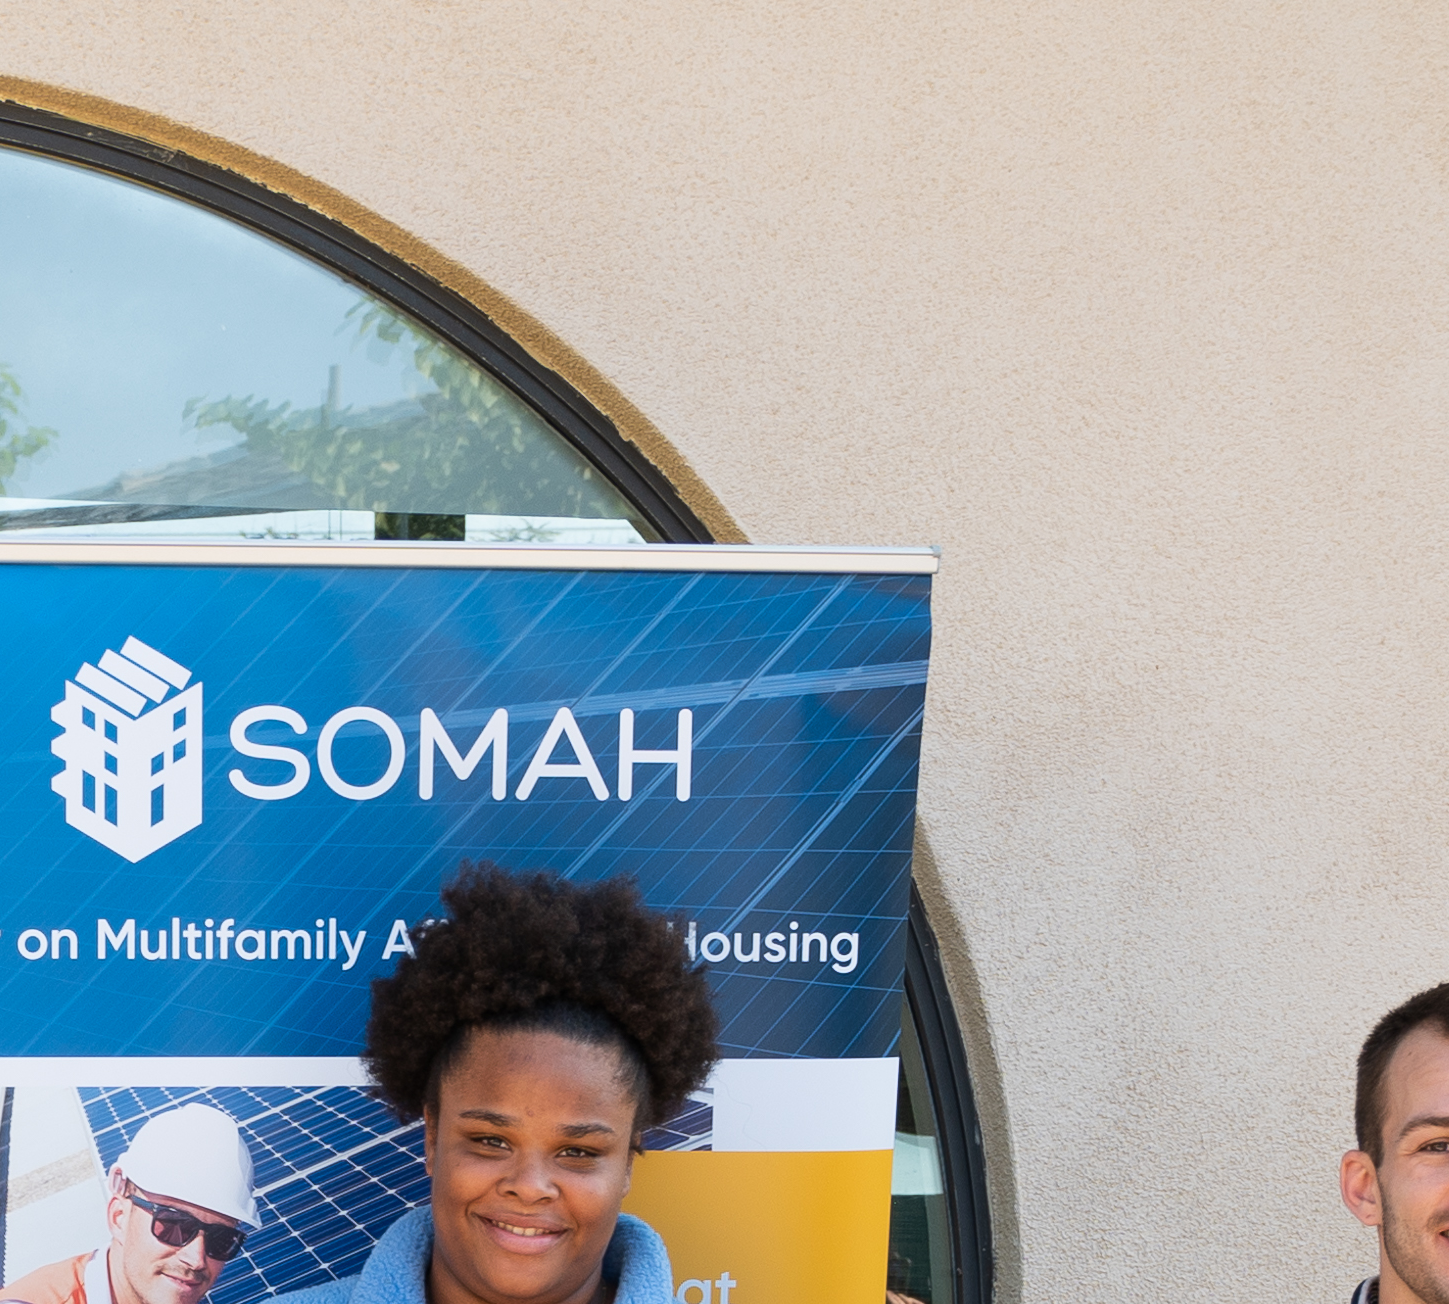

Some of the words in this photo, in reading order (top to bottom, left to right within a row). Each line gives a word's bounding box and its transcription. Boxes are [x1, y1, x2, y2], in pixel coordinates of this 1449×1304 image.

[228, 704, 693, 802] SOMAH
[17, 928, 78, 961] on
[98, 917, 367, 971] Multifamily
